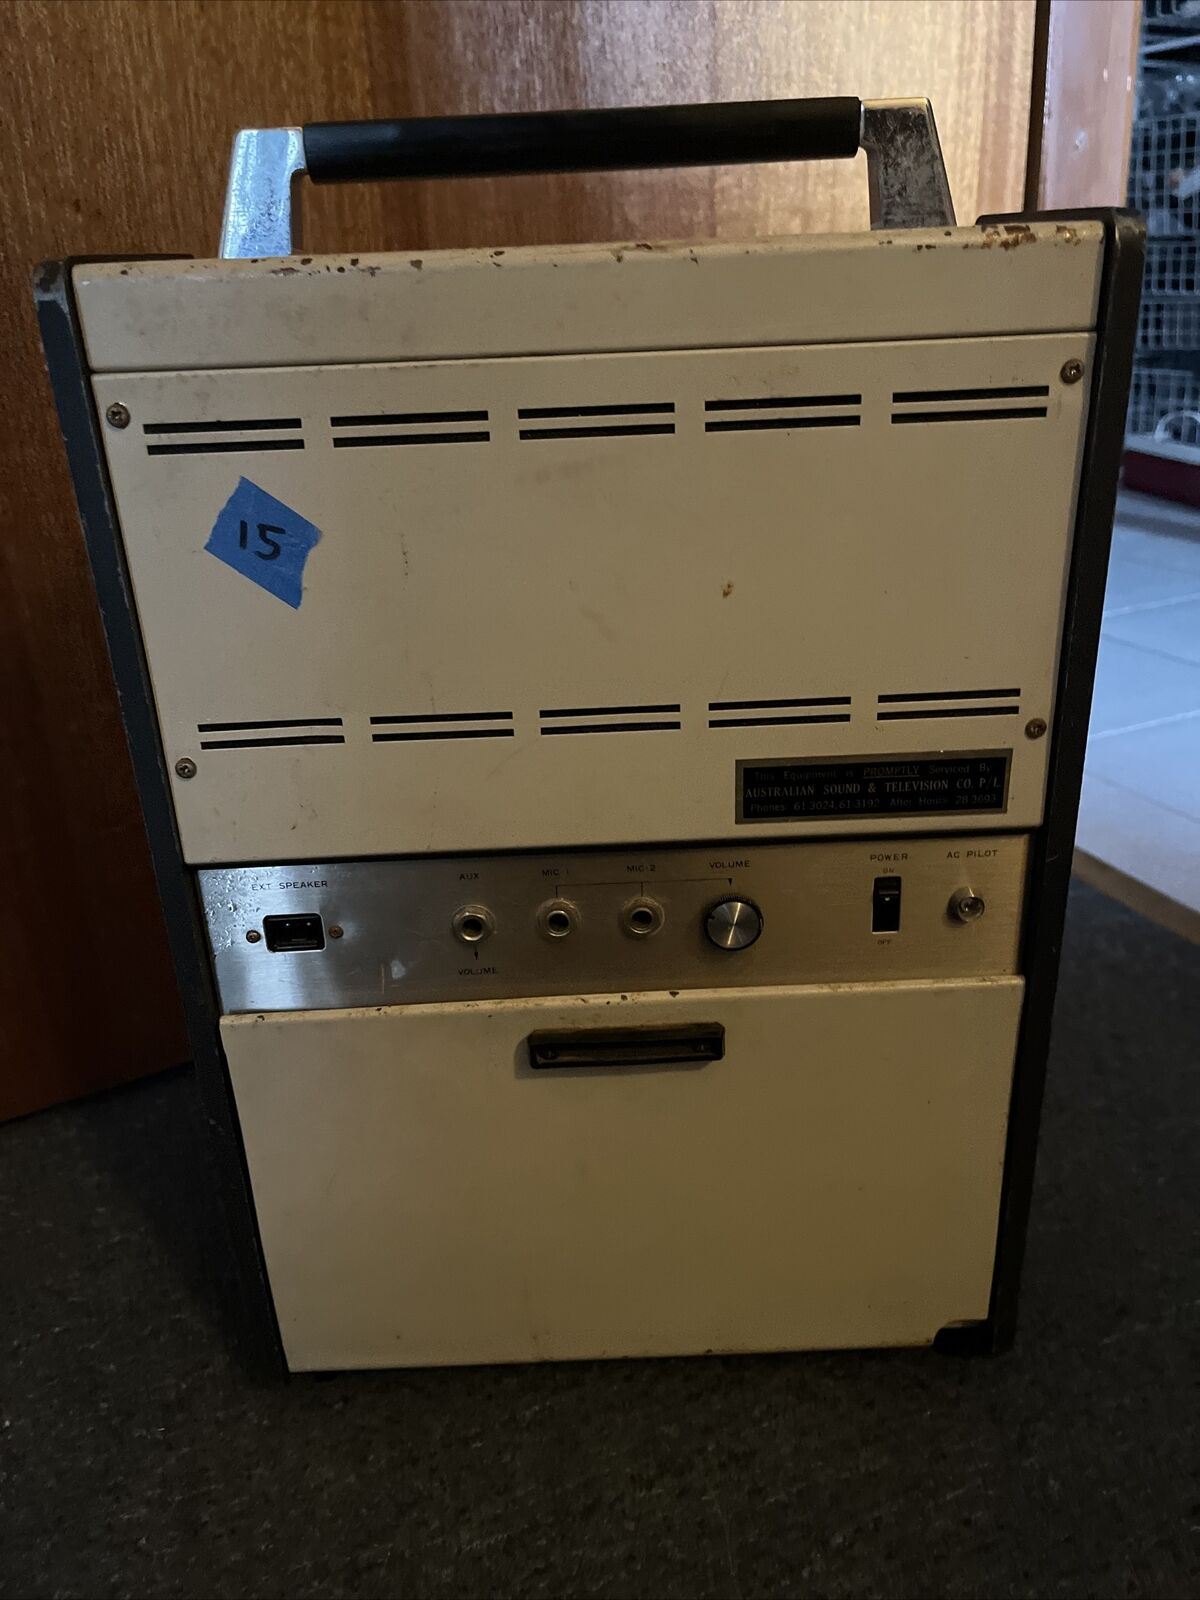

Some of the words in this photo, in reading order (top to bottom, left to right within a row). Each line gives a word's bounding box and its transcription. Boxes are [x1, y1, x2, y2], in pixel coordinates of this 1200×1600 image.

[239, 519, 286, 561] 15
[745, 785, 815, 799] AUSTRALIAN
[823, 783, 861, 796] SOUND
[867, 782, 877, 794] &
[885, 778, 949, 794] TELEVISION
[870, 852, 909, 862] POWER
[946, 851, 960, 859] AC
[966, 849, 998, 858] PILOT
[626, 864, 645, 873] MIC
[709, 859, 751, 870] VOLUME
[458, 872, 480, 881] AUX
[541, 868, 560, 877] MIC
[251, 884, 273, 892] EXT
[278, 880, 329, 891] SPEAKER
[457, 966, 499, 976] VOLUME
